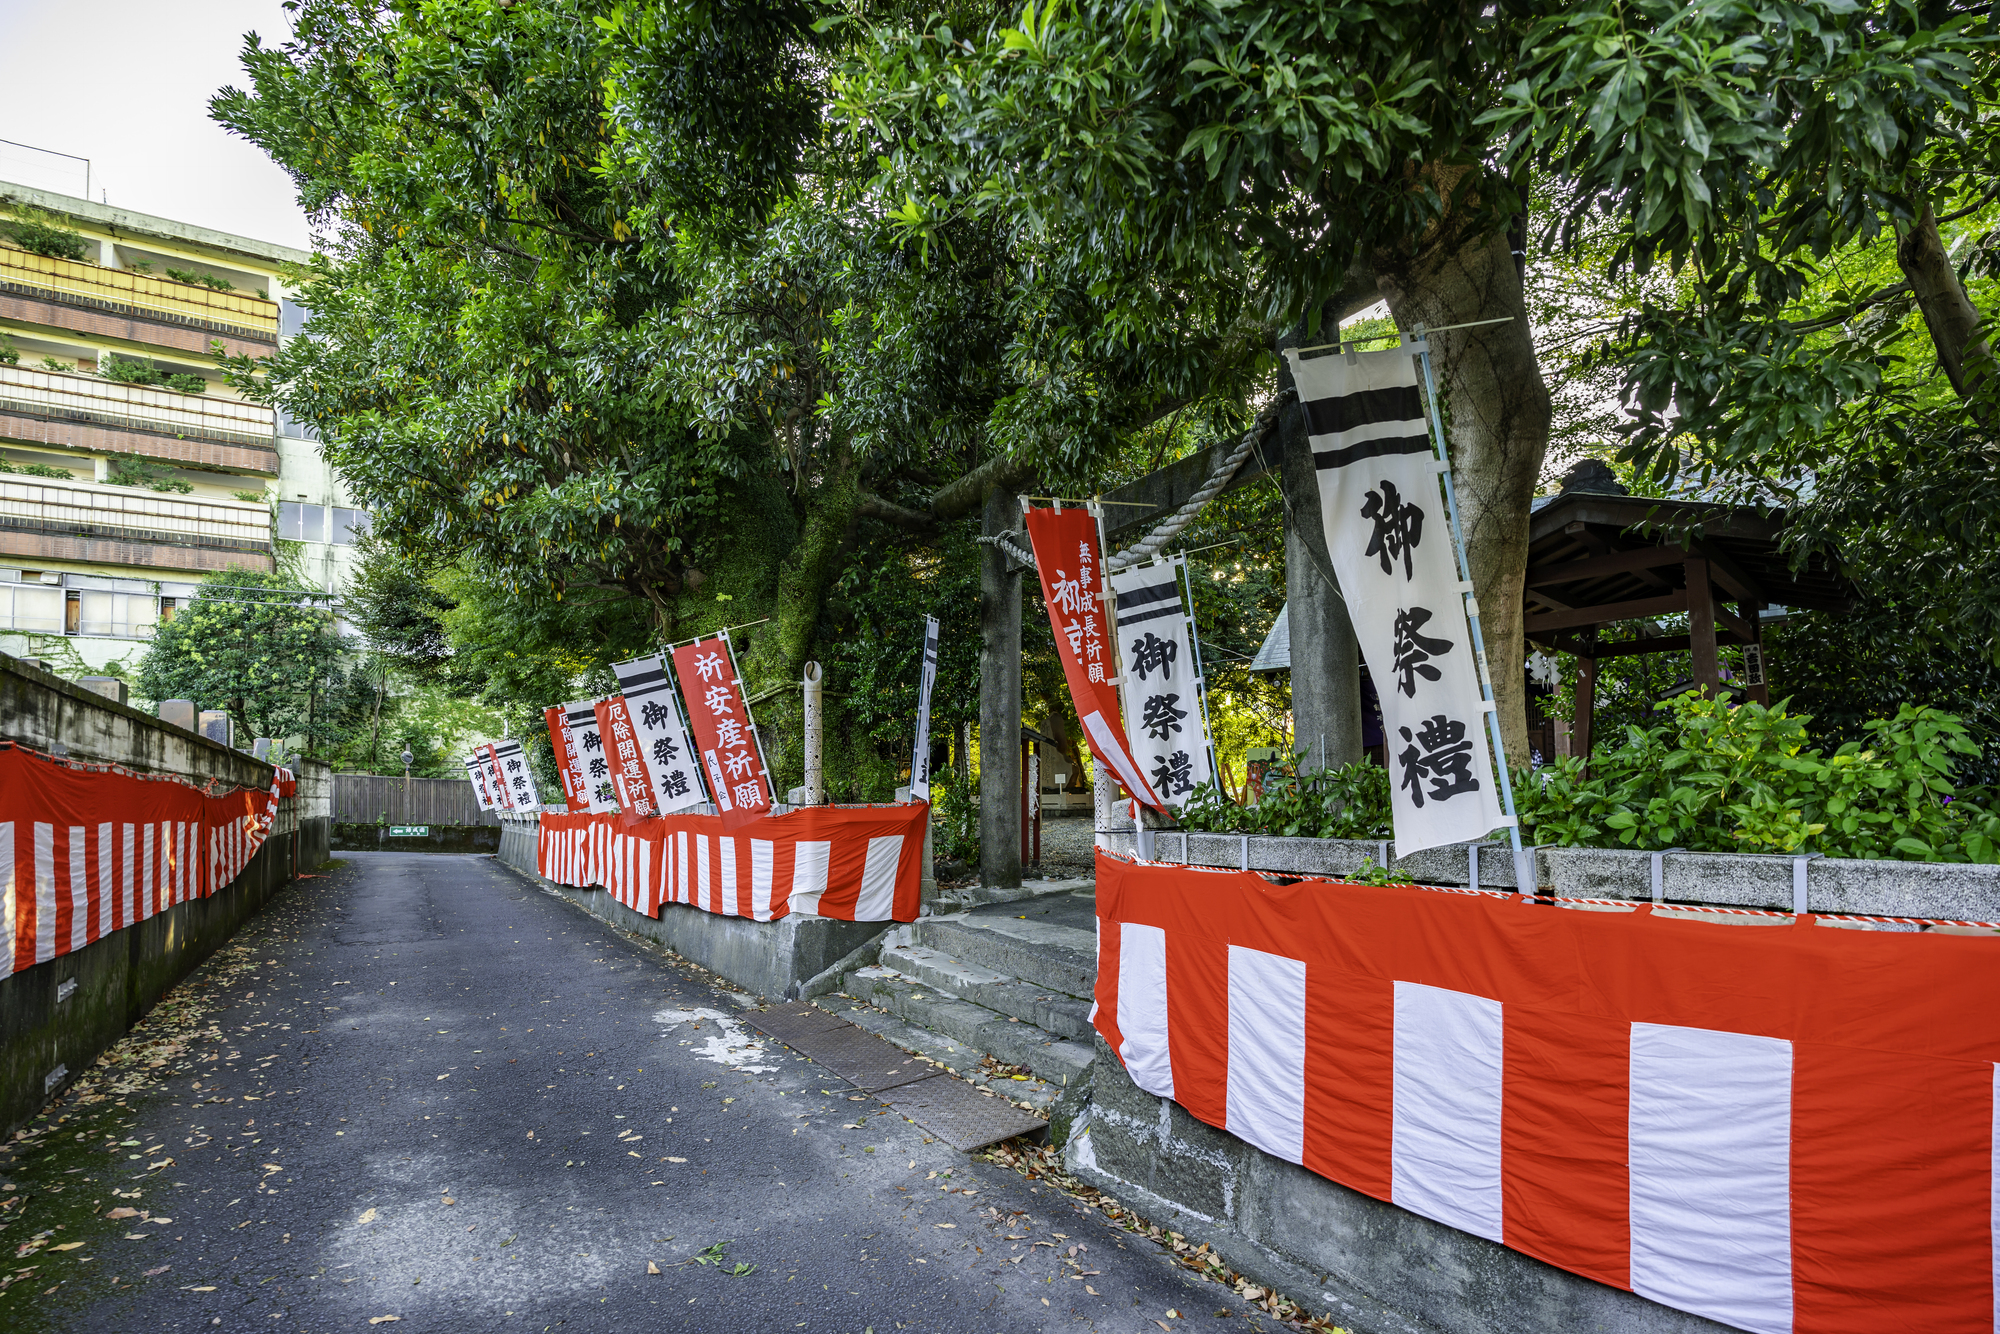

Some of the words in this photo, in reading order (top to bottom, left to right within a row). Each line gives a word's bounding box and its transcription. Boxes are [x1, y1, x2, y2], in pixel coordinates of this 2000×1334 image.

[1079, 540, 1106, 684] 無事成長祈願
[1360, 479, 1480, 808] 御祭禮
[506, 759, 532, 806] 御祭禮
[609, 703, 654, 816] 厄除開運祈願
[641, 700, 690, 800] 御祭禮
[694, 651, 764, 810] 祈安産祈願
[1131, 632, 1196, 799] 御祭禮
